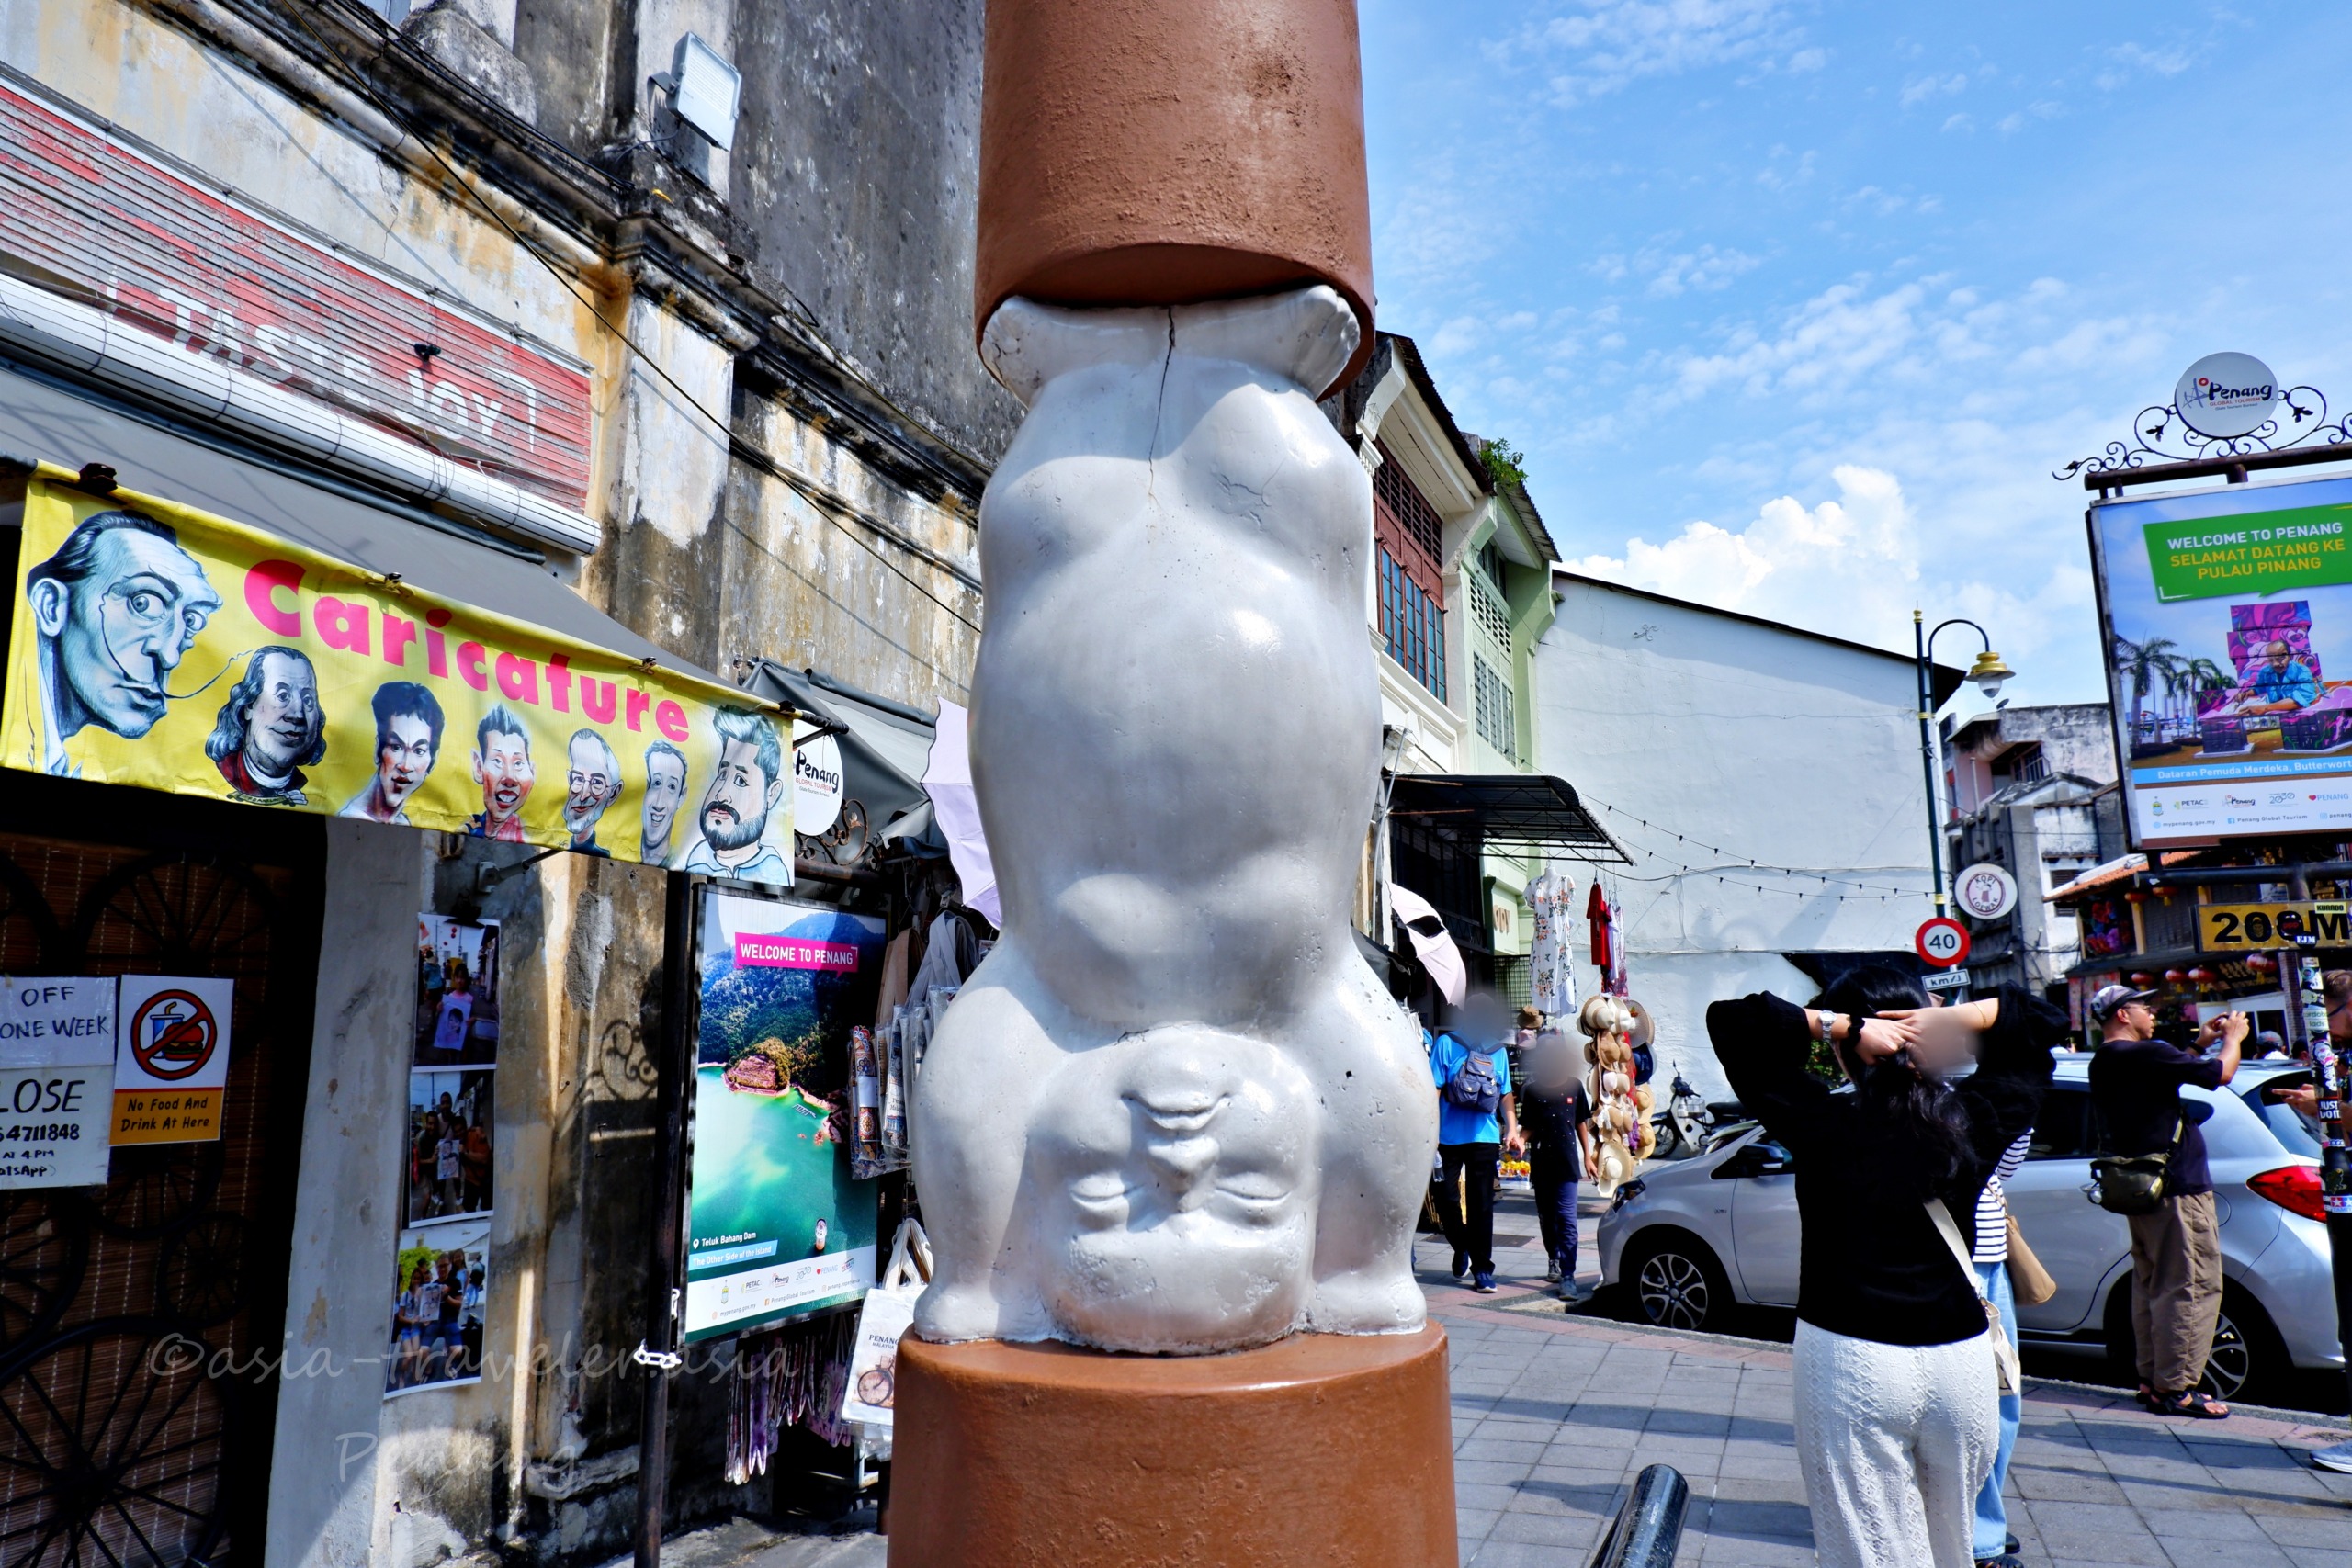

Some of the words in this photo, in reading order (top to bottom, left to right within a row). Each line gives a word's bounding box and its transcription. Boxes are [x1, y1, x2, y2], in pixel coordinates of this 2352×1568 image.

[159, 288, 372, 406] TASTE
[394, 369, 504, 444] JOY
[2209, 381, 2273, 401] Penang
[2167, 531, 2247, 549] WELCOME
[2250, 529, 2271, 541] TO
[2276, 522, 2343, 539] PENANG
[2170, 548, 2246, 567] SELAMAT
[2251, 541, 2319, 559] DATANG
[2323, 538, 2346, 552] KE
[2198, 563, 2253, 580] PULAU
[2257, 557, 2322, 574] PINANG
[243, 558, 690, 743] Caricature
[796, 749, 840, 795] Penang
[2158, 770, 2198, 779] Dataran
[2200, 766, 2242, 776] Pemuda
[2244, 764, 2292, 773] Merdeka,
[795, 777, 813, 787] GLOBAL
[2231, 796, 2256, 807] Penang
[2269, 792, 2295, 805] 2030
[2317, 793, 2349, 801] PENANG
[2163, 819, 2215, 828] mypenang.gov.my
[1974, 875, 1997, 885] KOPI
[1972, 897, 1998, 911] LOEWAK
[1929, 933, 1956, 950] 40
[741, 942, 796, 962] WELCOME
[799, 947, 812, 963] TO
[814, 949, 854, 965] PENANG
[1930, 974, 1962, 987] km/j
[21, 986, 75, 1007] OFF
[0, 1020, 46, 1039] ONE
[52, 1015, 109, 1038] WEEK
[127, 1098, 143, 1111] No
[150, 1097, 179, 1111] Food
[184, 1096, 209, 1110] And
[2320, 1100, 2338, 1110] JUST
[120, 1118, 156, 1133] Drink
[162, 1119, 176, 1131] At
[183, 1117, 209, 1129] Here
[20, 1150, 32, 1159] 4
[701, 1237, 719, 1247] Teluk
[720, 1234, 743, 1244] Bahang
[744, 1231, 757, 1239] Dam
[693, 1258, 706, 1266] The
[707, 1255, 723, 1265] Other
[725, 1253, 739, 1261] Side
[745, 1249, 755, 1258] the
[755, 1246, 772, 1256] Island
[745, 1280, 762, 1289] PETAC
[771, 1295, 786, 1303] Penang
[786, 1292, 799, 1300] Global
[799, 1289, 816, 1297] Tourism
